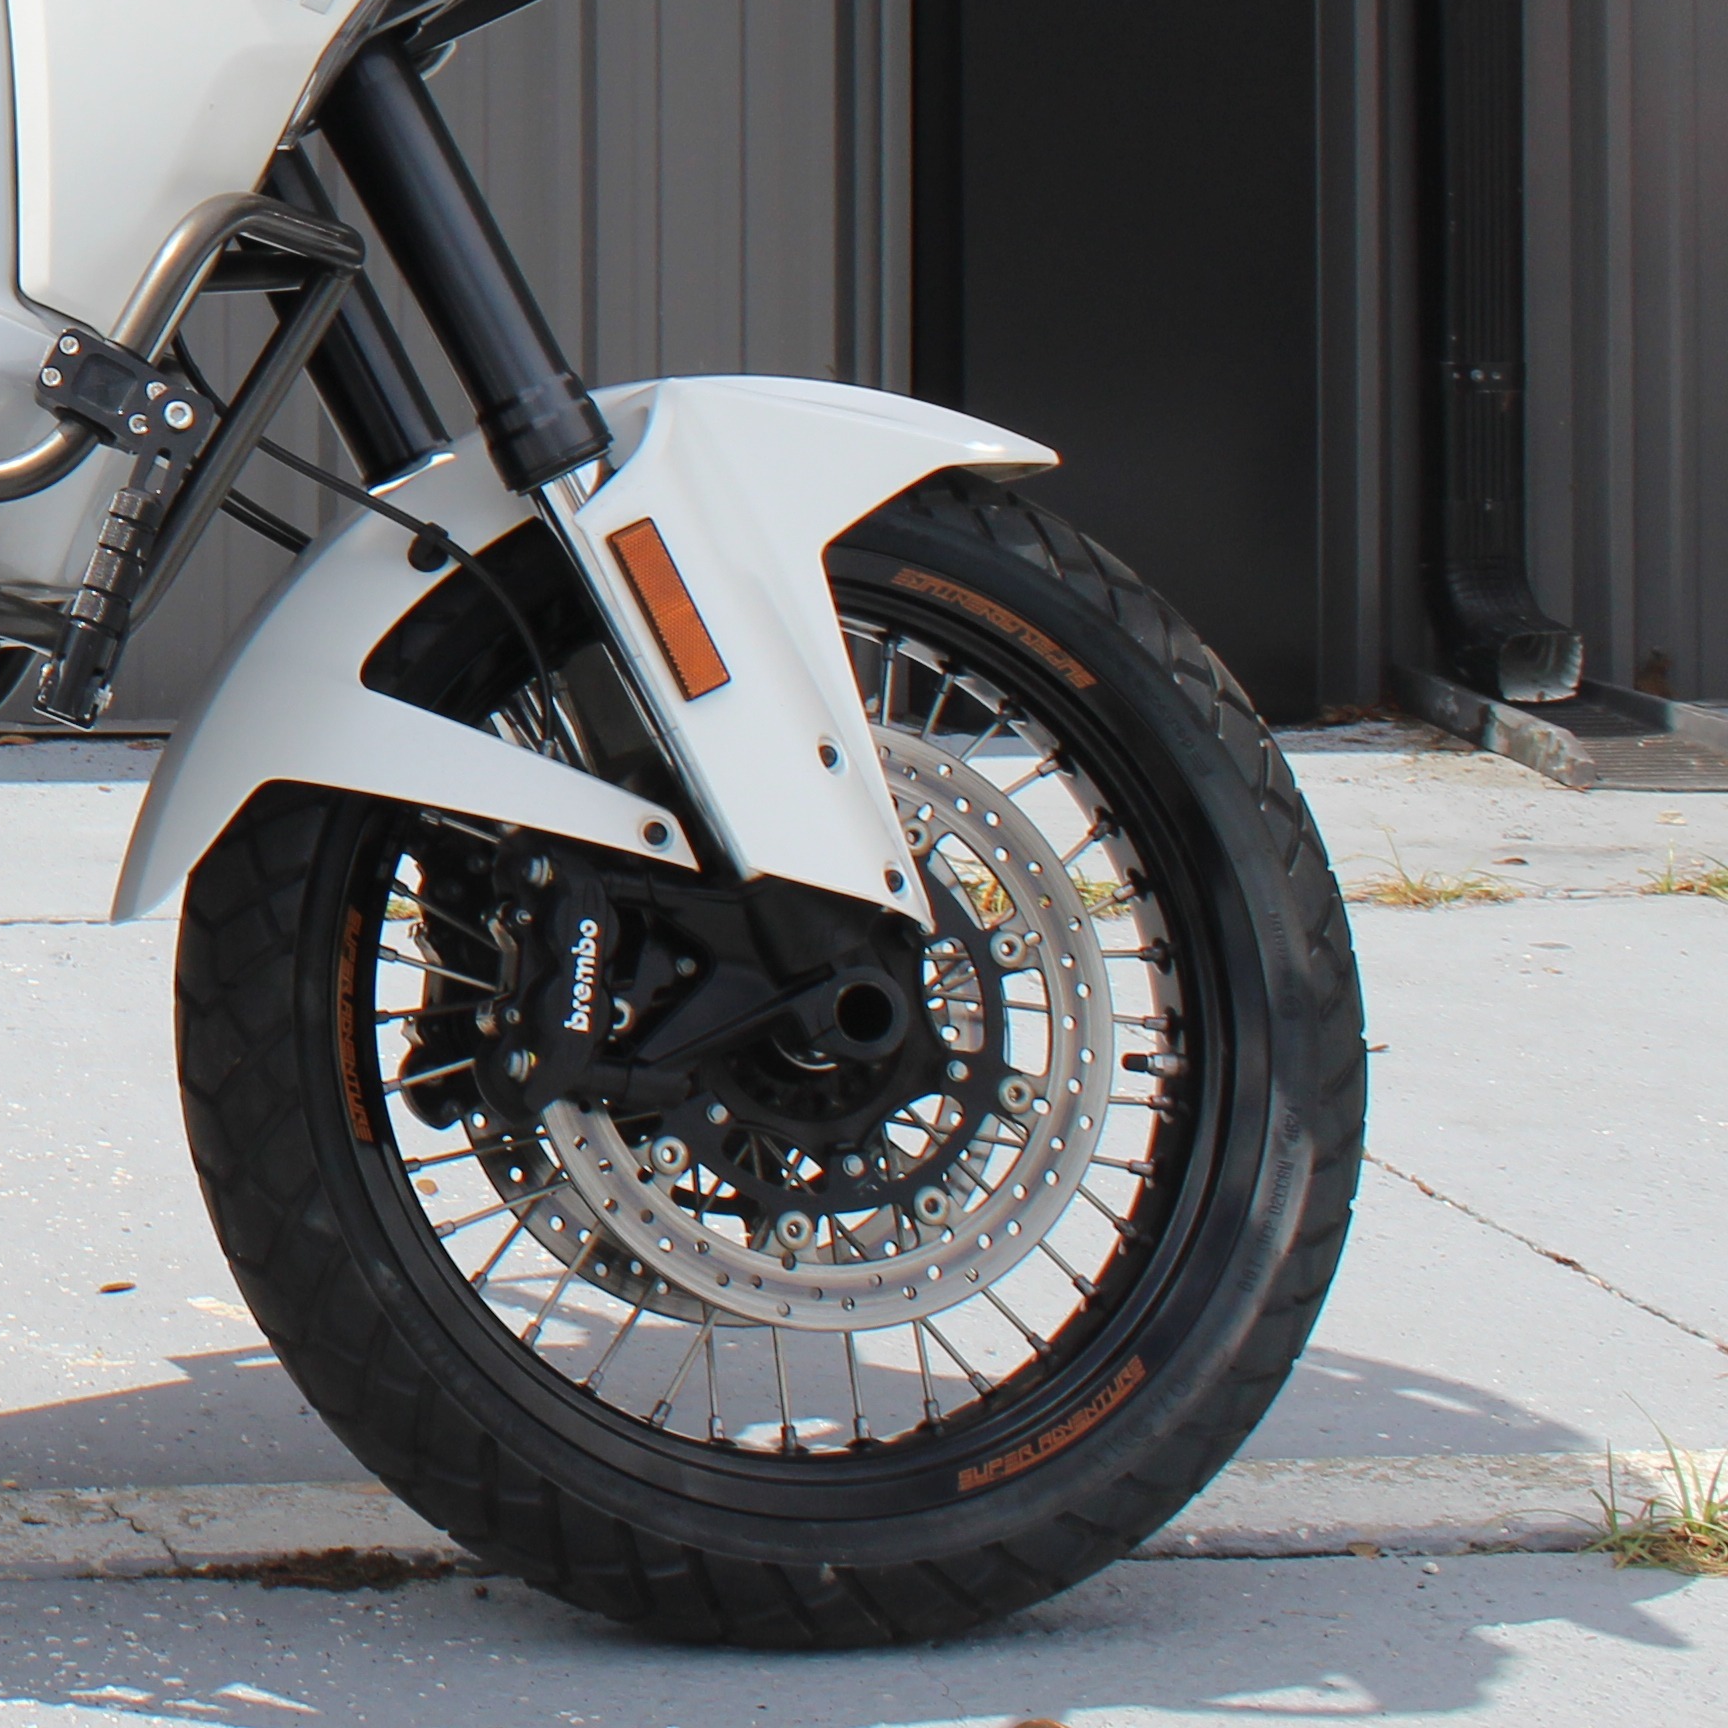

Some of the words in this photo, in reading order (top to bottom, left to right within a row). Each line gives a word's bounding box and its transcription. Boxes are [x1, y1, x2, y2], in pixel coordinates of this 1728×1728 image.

[563, 918, 600, 1033] brembo
[957, 1445, 1034, 1492] SUPER
[1037, 1354, 1147, 1457] ADVENTURE
